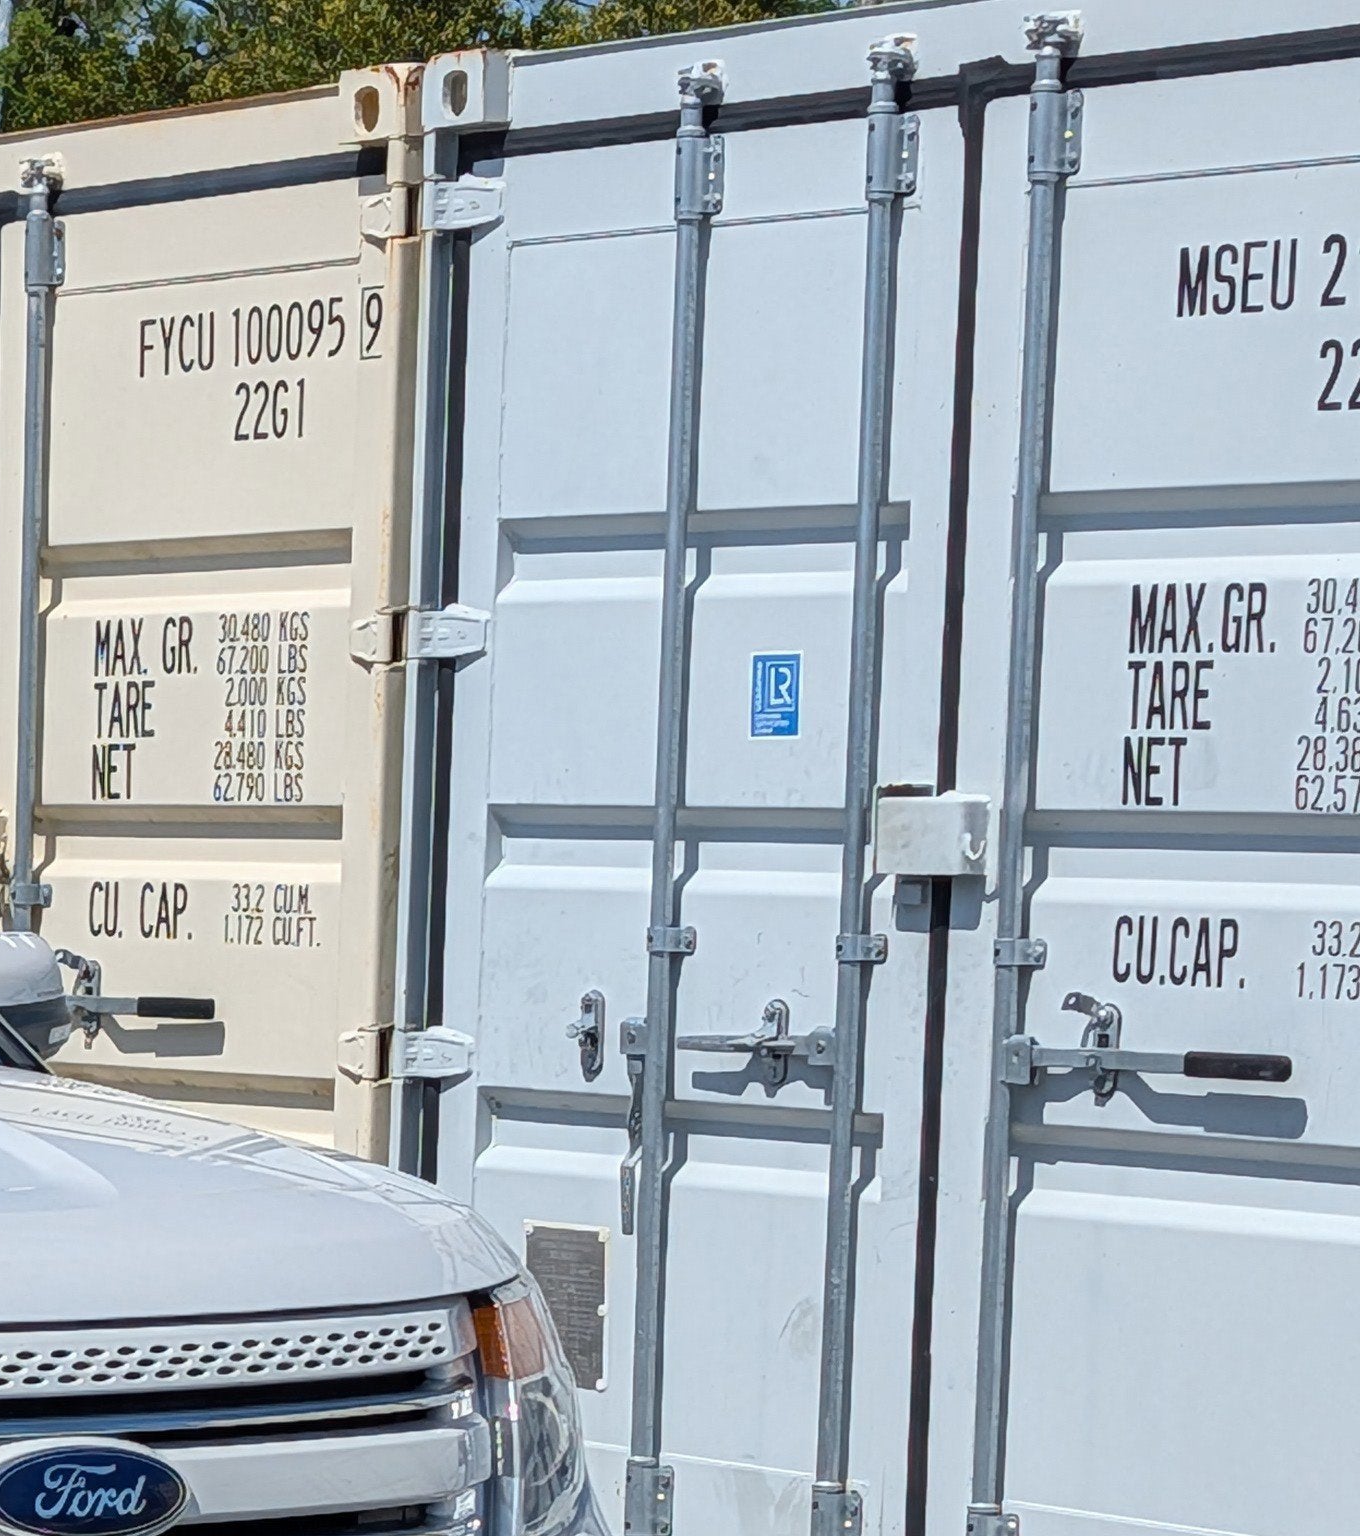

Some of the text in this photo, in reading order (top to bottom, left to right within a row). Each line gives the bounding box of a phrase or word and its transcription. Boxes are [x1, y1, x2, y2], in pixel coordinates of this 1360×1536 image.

[1177, 234, 1360, 318] MSEU 2
[139, 292, 383, 378] FYCU 100095 9
[233, 377, 306, 441] 22G1
[93, 615, 198, 677] MAX. GR.
[278, 611, 310, 642] KGS
[1303, 617, 1360, 655] 67,2
[277, 644, 308, 674] LBS
[93, 680, 156, 739] TARE
[275, 676, 307, 706] KGS
[1127, 660, 1214, 730] TARE
[275, 708, 305, 738] LBS
[91, 742, 137, 801] NET
[274, 740, 305, 771] KGS
[1121, 736, 1188, 806] NET
[274, 771, 304, 802] LBS
[88, 881, 193, 940] CU. CAP.
[35, 1463, 147, 1519] Ford
